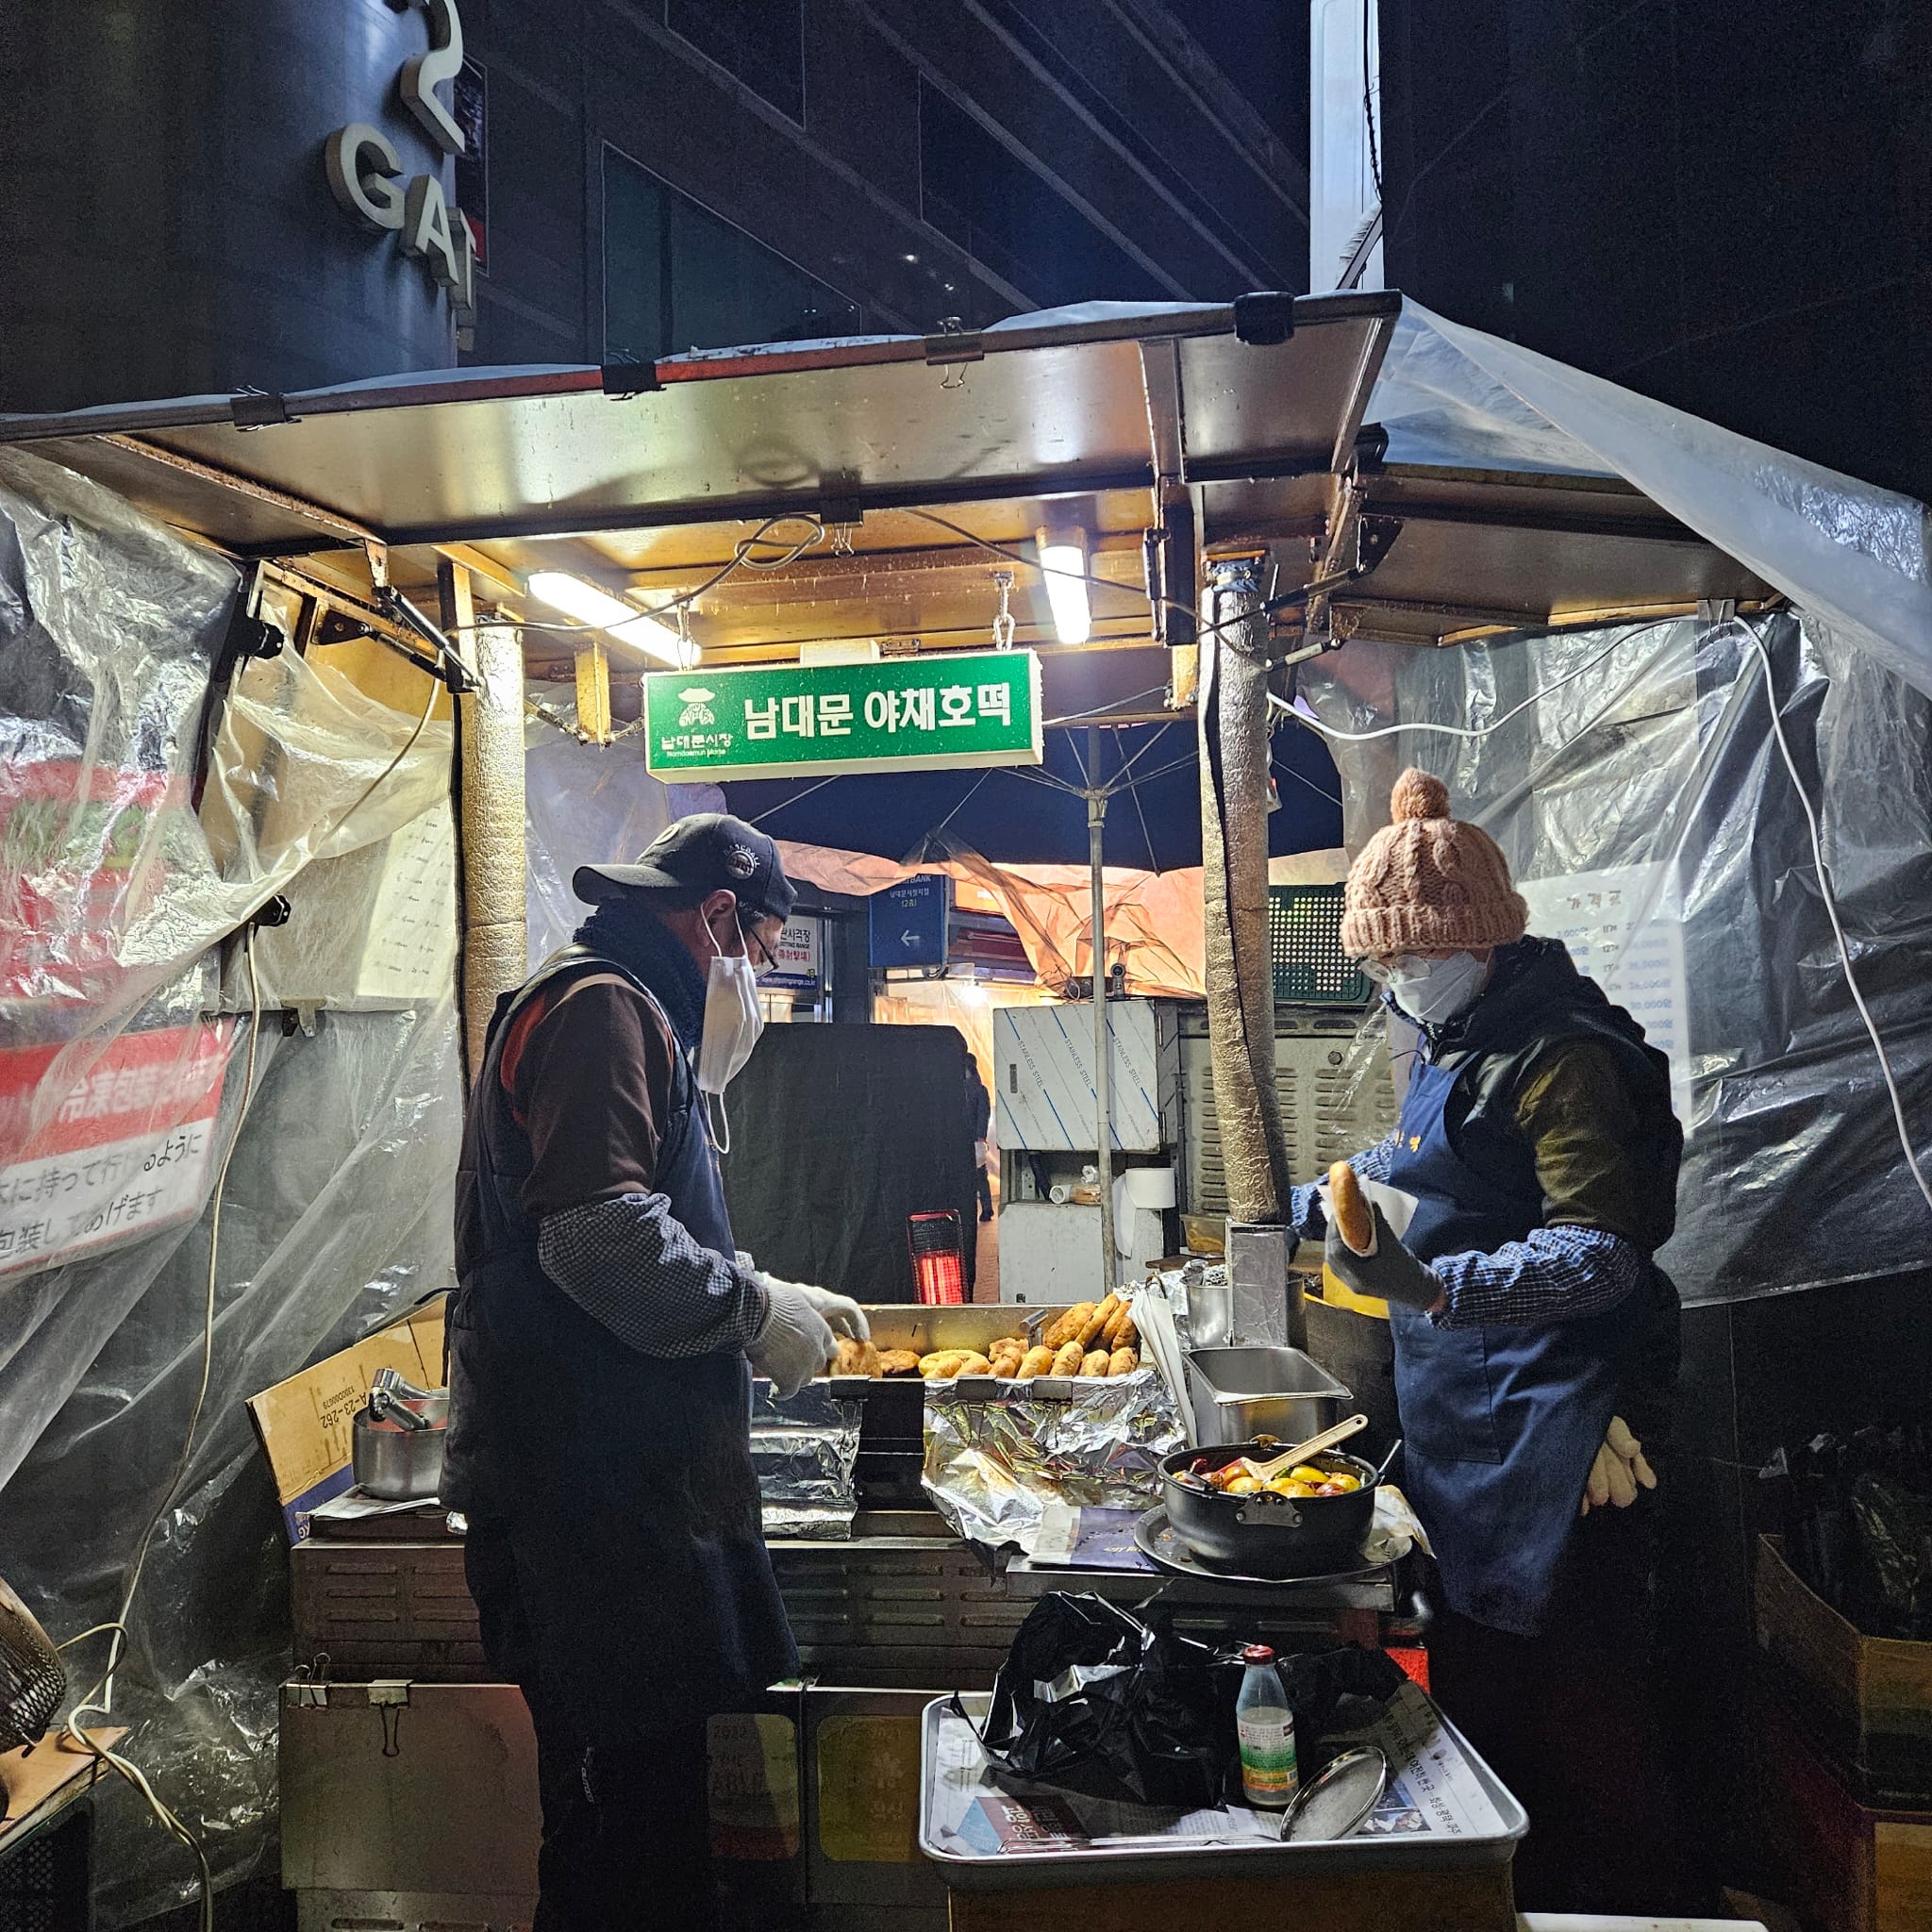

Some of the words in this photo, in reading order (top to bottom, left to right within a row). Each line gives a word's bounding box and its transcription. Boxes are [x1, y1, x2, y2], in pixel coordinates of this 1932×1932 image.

[326, 123, 476, 325] GAT
[744, 694, 854, 741] 남대문
[864, 682, 1010, 733] 야채호떡
[661, 733, 733, 750] 남대문시장
[1032, 1071, 1044, 1088] STEEL
[1079, 1070, 1091, 1087] STEEL
[1128, 1068, 1141, 1086] STEEL
[320, 1391, 368, 1429] A-23-262
